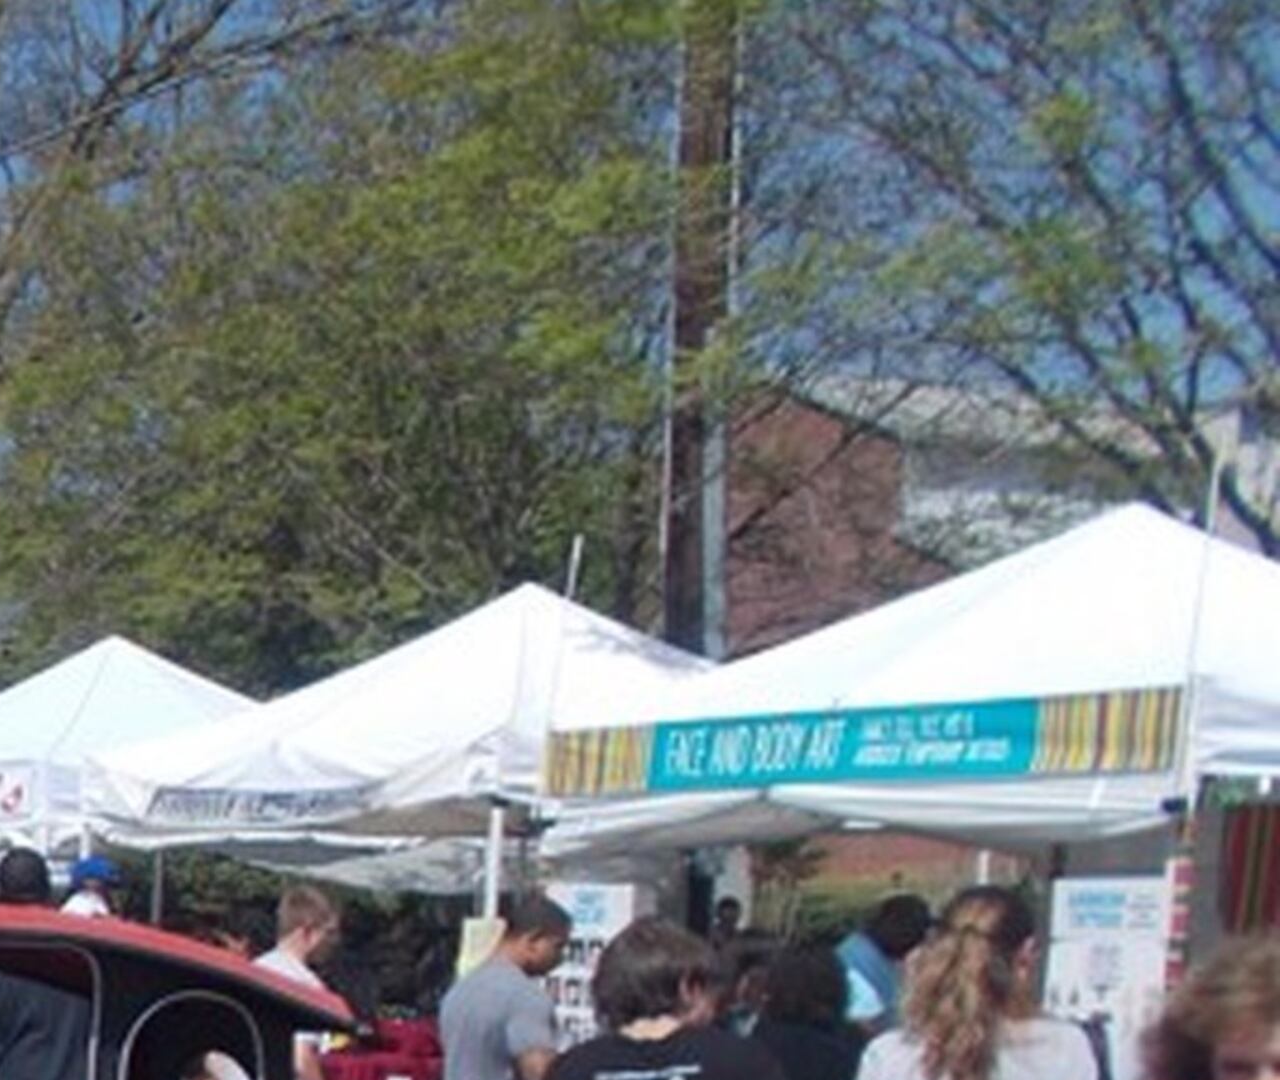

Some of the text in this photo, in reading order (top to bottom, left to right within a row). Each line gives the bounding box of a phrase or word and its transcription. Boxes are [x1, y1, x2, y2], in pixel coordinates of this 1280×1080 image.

[664, 727, 707, 778] FACE
[709, 724, 750, 776] AND
[751, 720, 806, 774] BODY
[802, 717, 848, 770] ART
